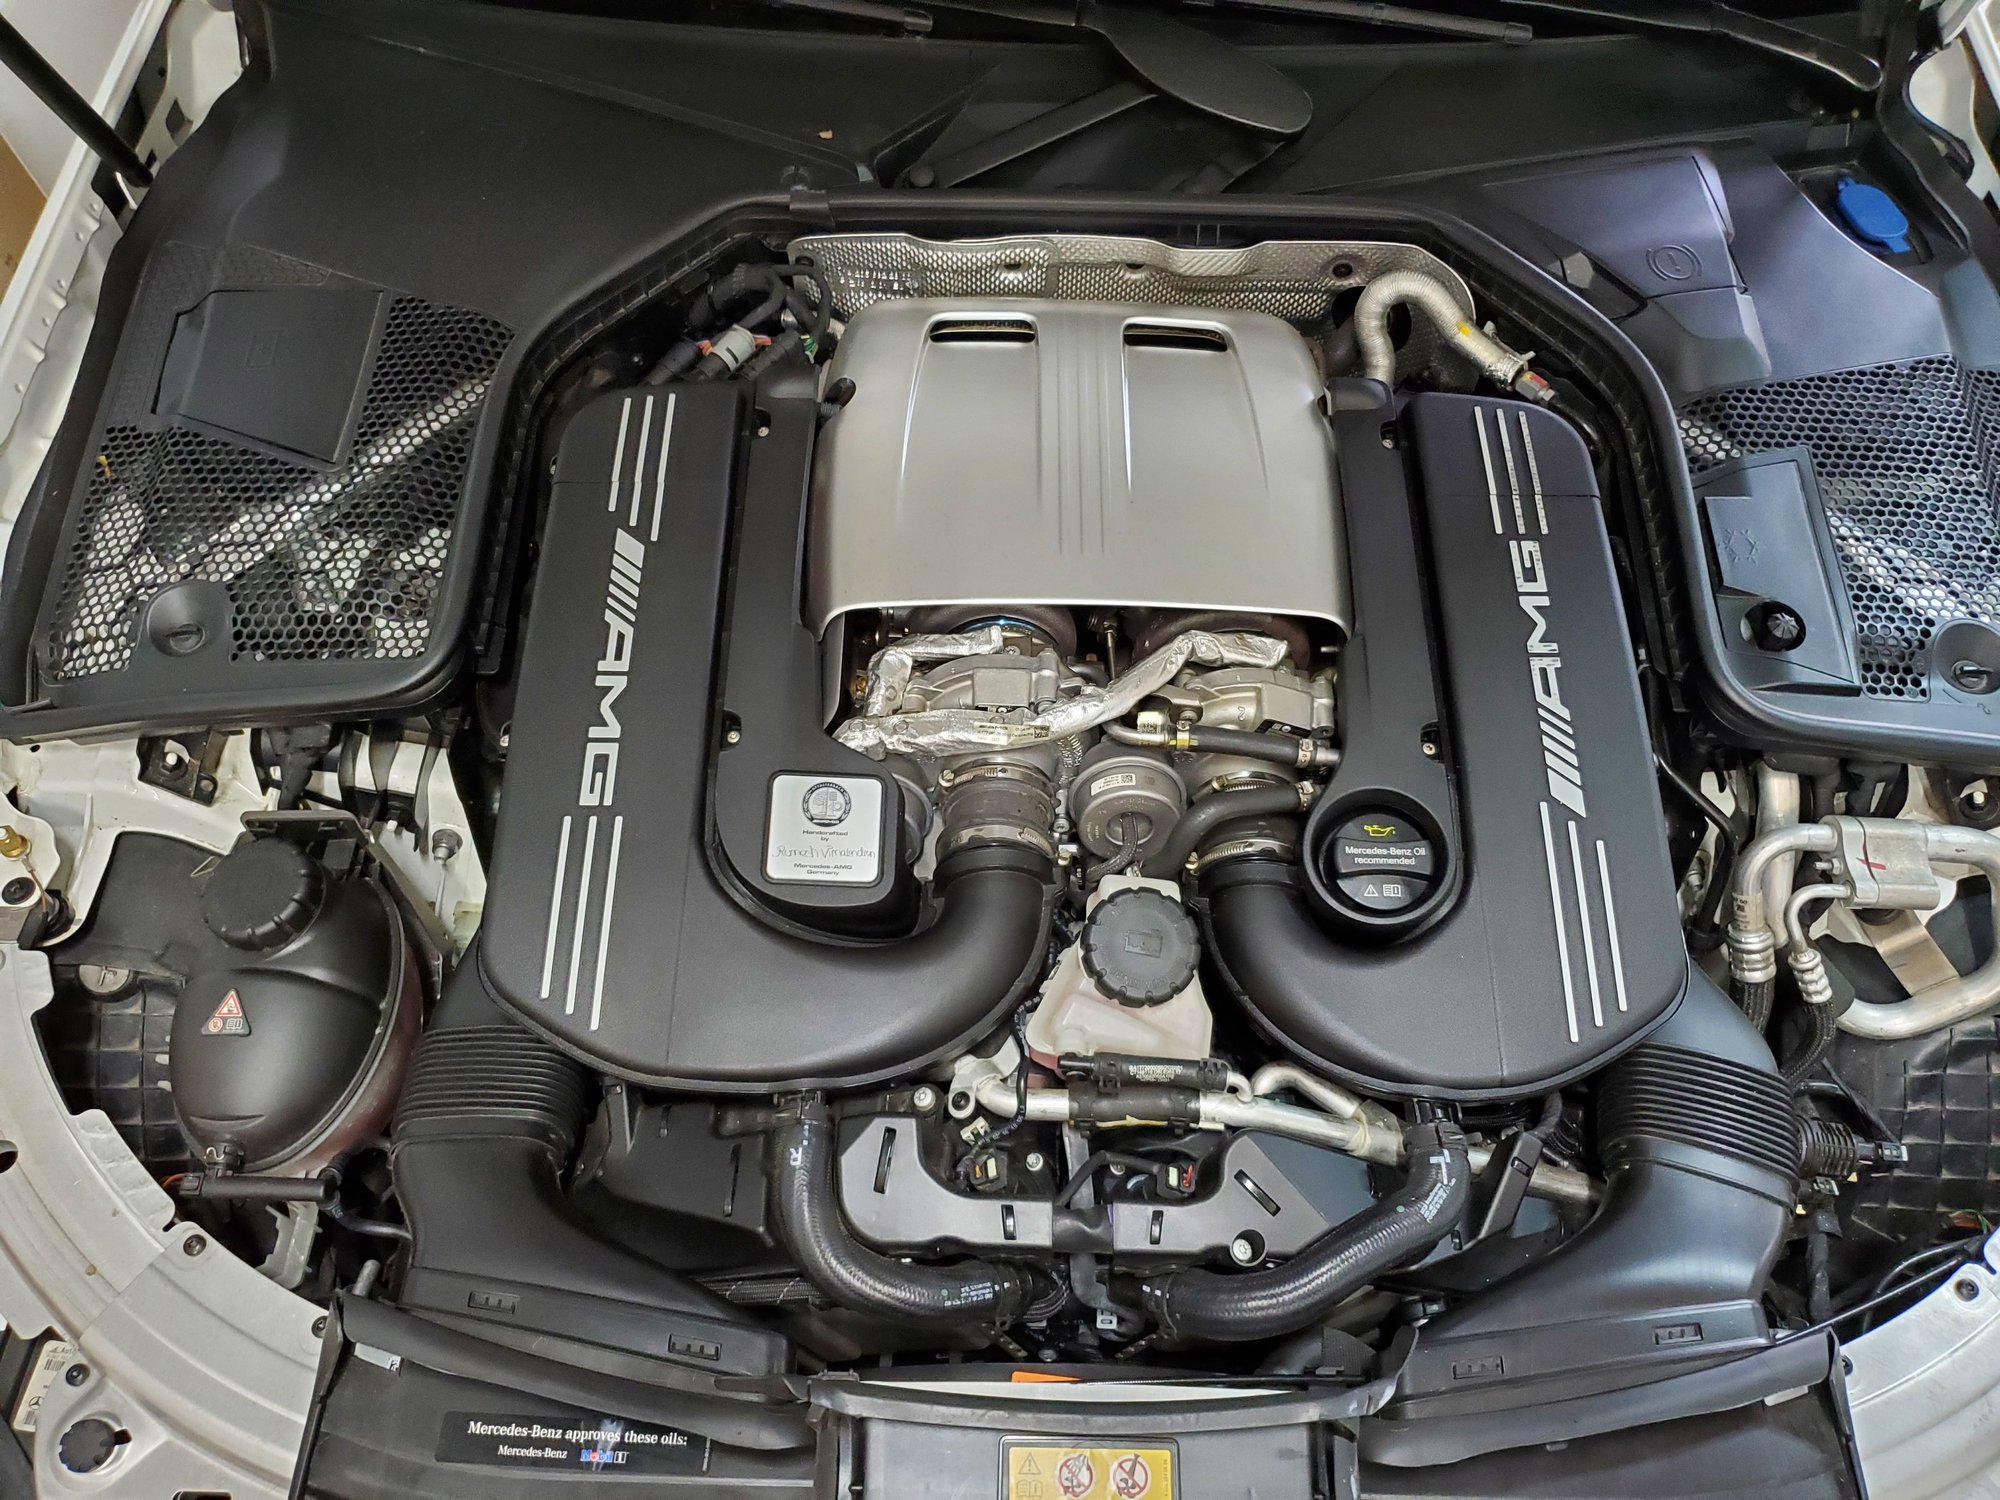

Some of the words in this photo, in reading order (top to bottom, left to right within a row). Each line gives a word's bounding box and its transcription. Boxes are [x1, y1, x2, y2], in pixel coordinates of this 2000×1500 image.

[1509, 541, 1571, 722] AMG
[579, 608, 634, 806] AMG
[1345, 846, 1412, 856] Mercedes-Benz
[1413, 847, 1426, 856] Oil
[793, 862, 853, 870] Mercedes-AMG
[1354, 857, 1416, 865] recommended
[467, 1421, 563, 1439] Mercedes-Benz
[564, 1429, 621, 1443] approves
[621, 1430, 658, 1444] these
[661, 1432, 688, 1446] oils:
[497, 1444, 568, 1459] Mercedes-Benz
[580, 1448, 615, 1463] Mobil
